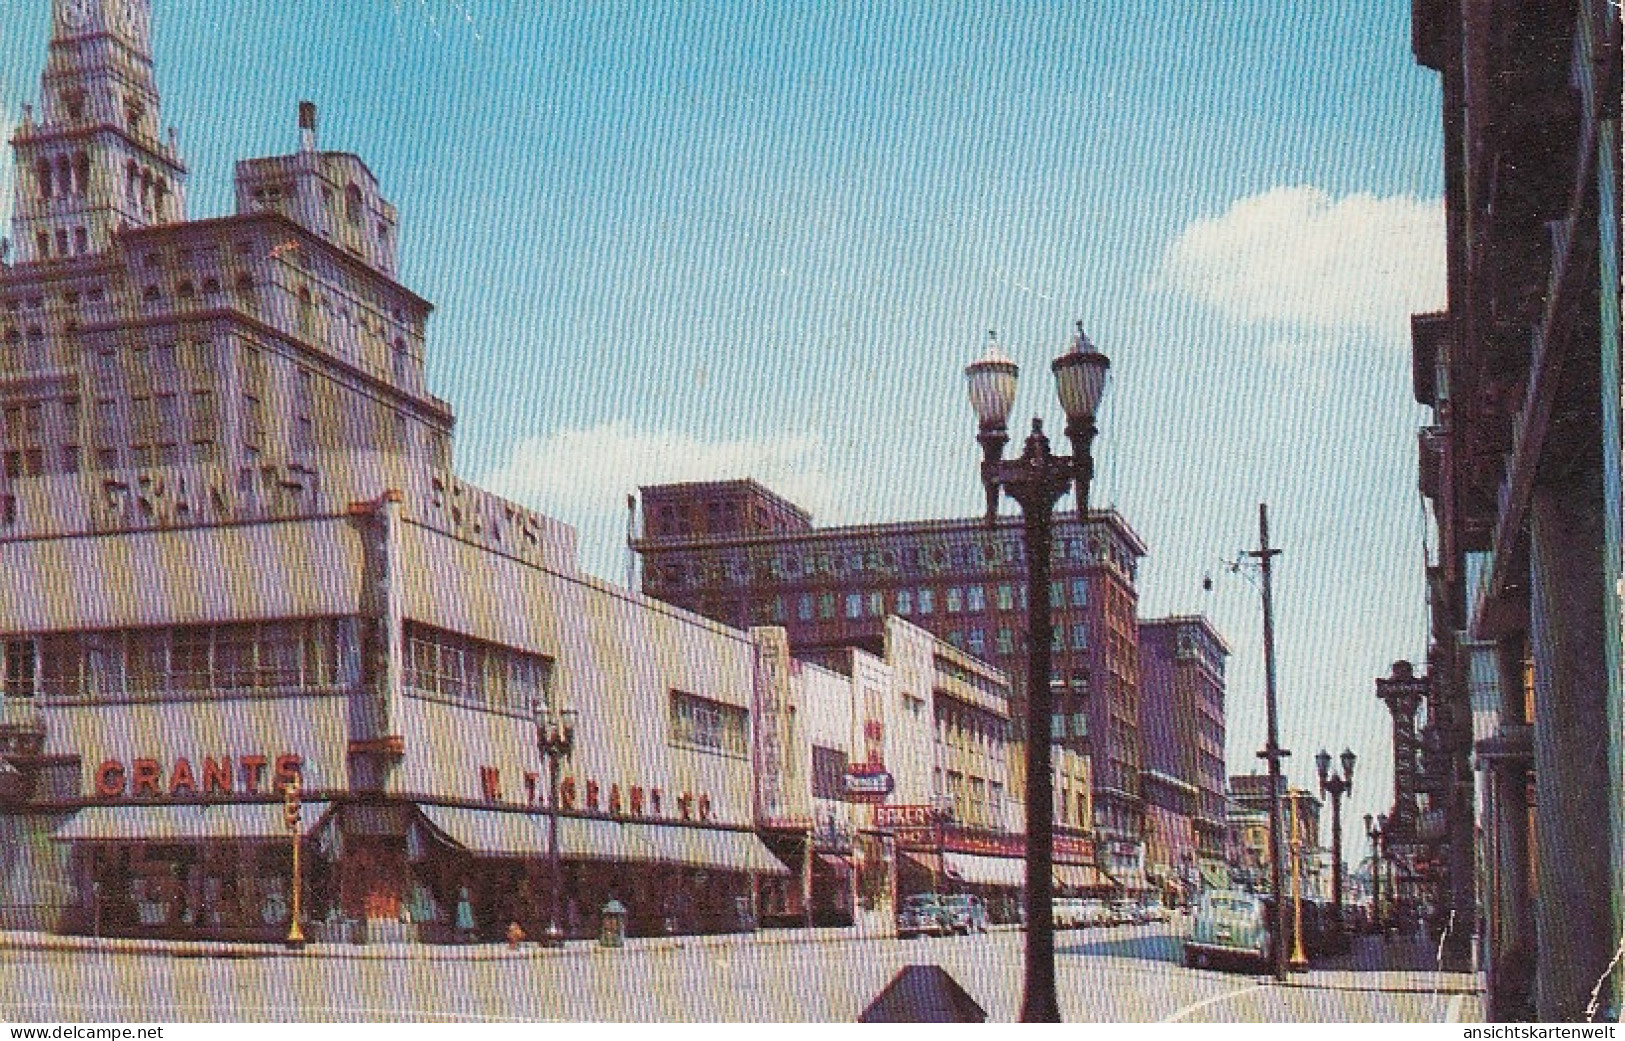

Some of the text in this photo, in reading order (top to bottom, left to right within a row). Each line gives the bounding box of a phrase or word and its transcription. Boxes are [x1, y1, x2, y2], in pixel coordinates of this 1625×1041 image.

[95, 753, 303, 797] GRANTS
[479, 764, 502, 799] W.
[523, 771, 544, 803] T.
[559, 776, 661, 817] GRANT
